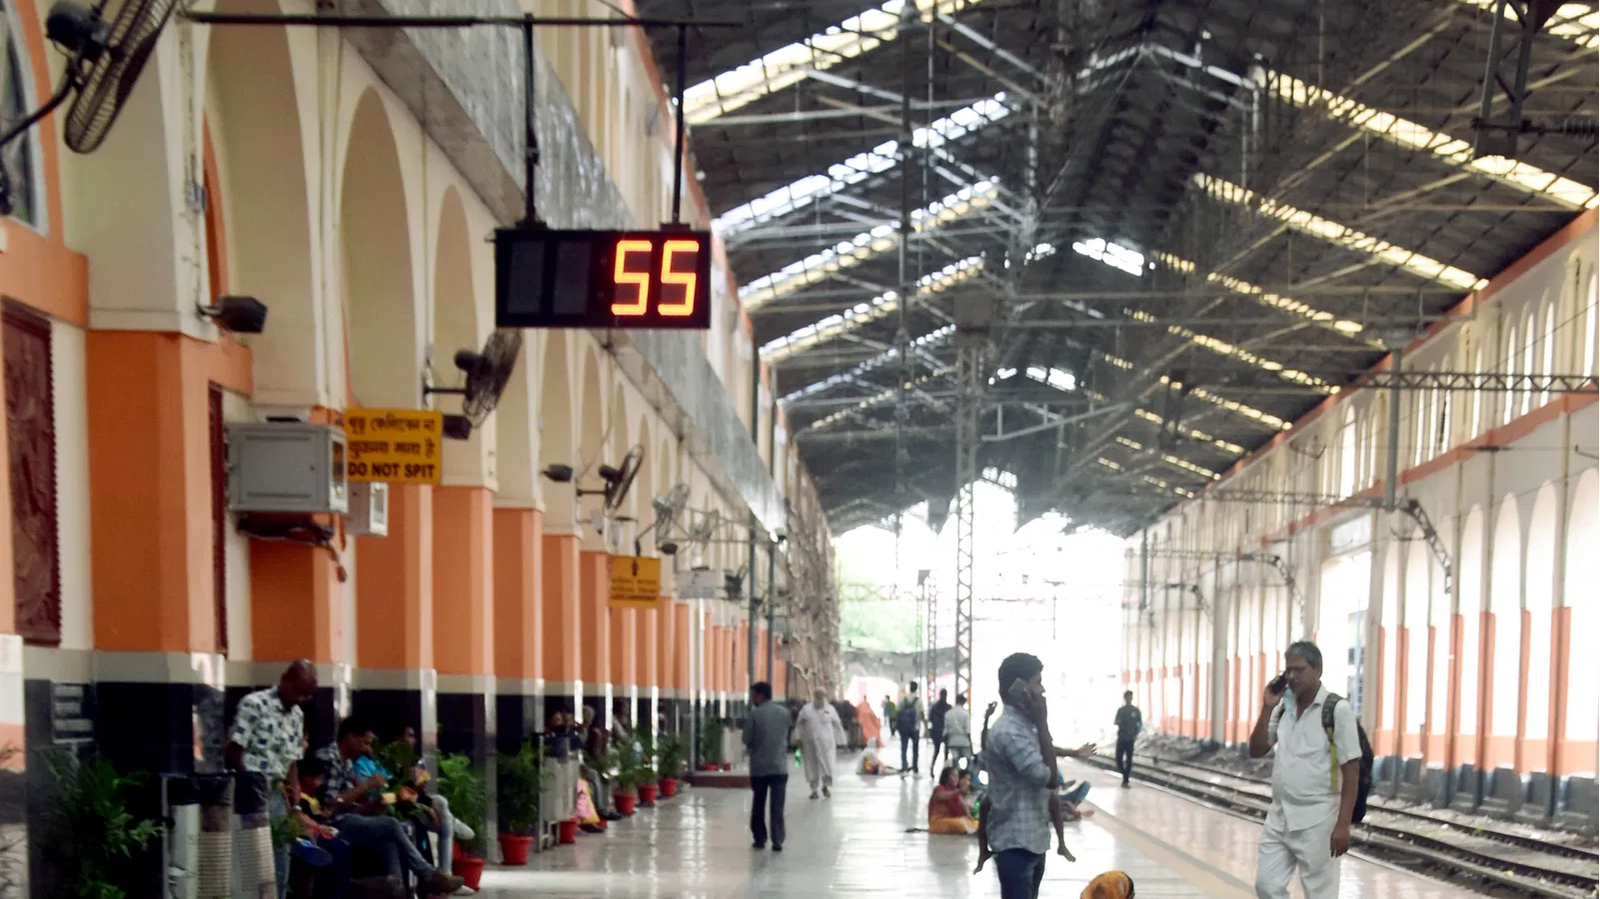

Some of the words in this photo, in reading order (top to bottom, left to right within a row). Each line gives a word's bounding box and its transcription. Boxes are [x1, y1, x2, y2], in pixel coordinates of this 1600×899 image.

[611, 239, 699, 316] 55
[348, 462, 367, 476] DO
[372, 462, 400, 476] NOT
[404, 463, 435, 478] SPIT
